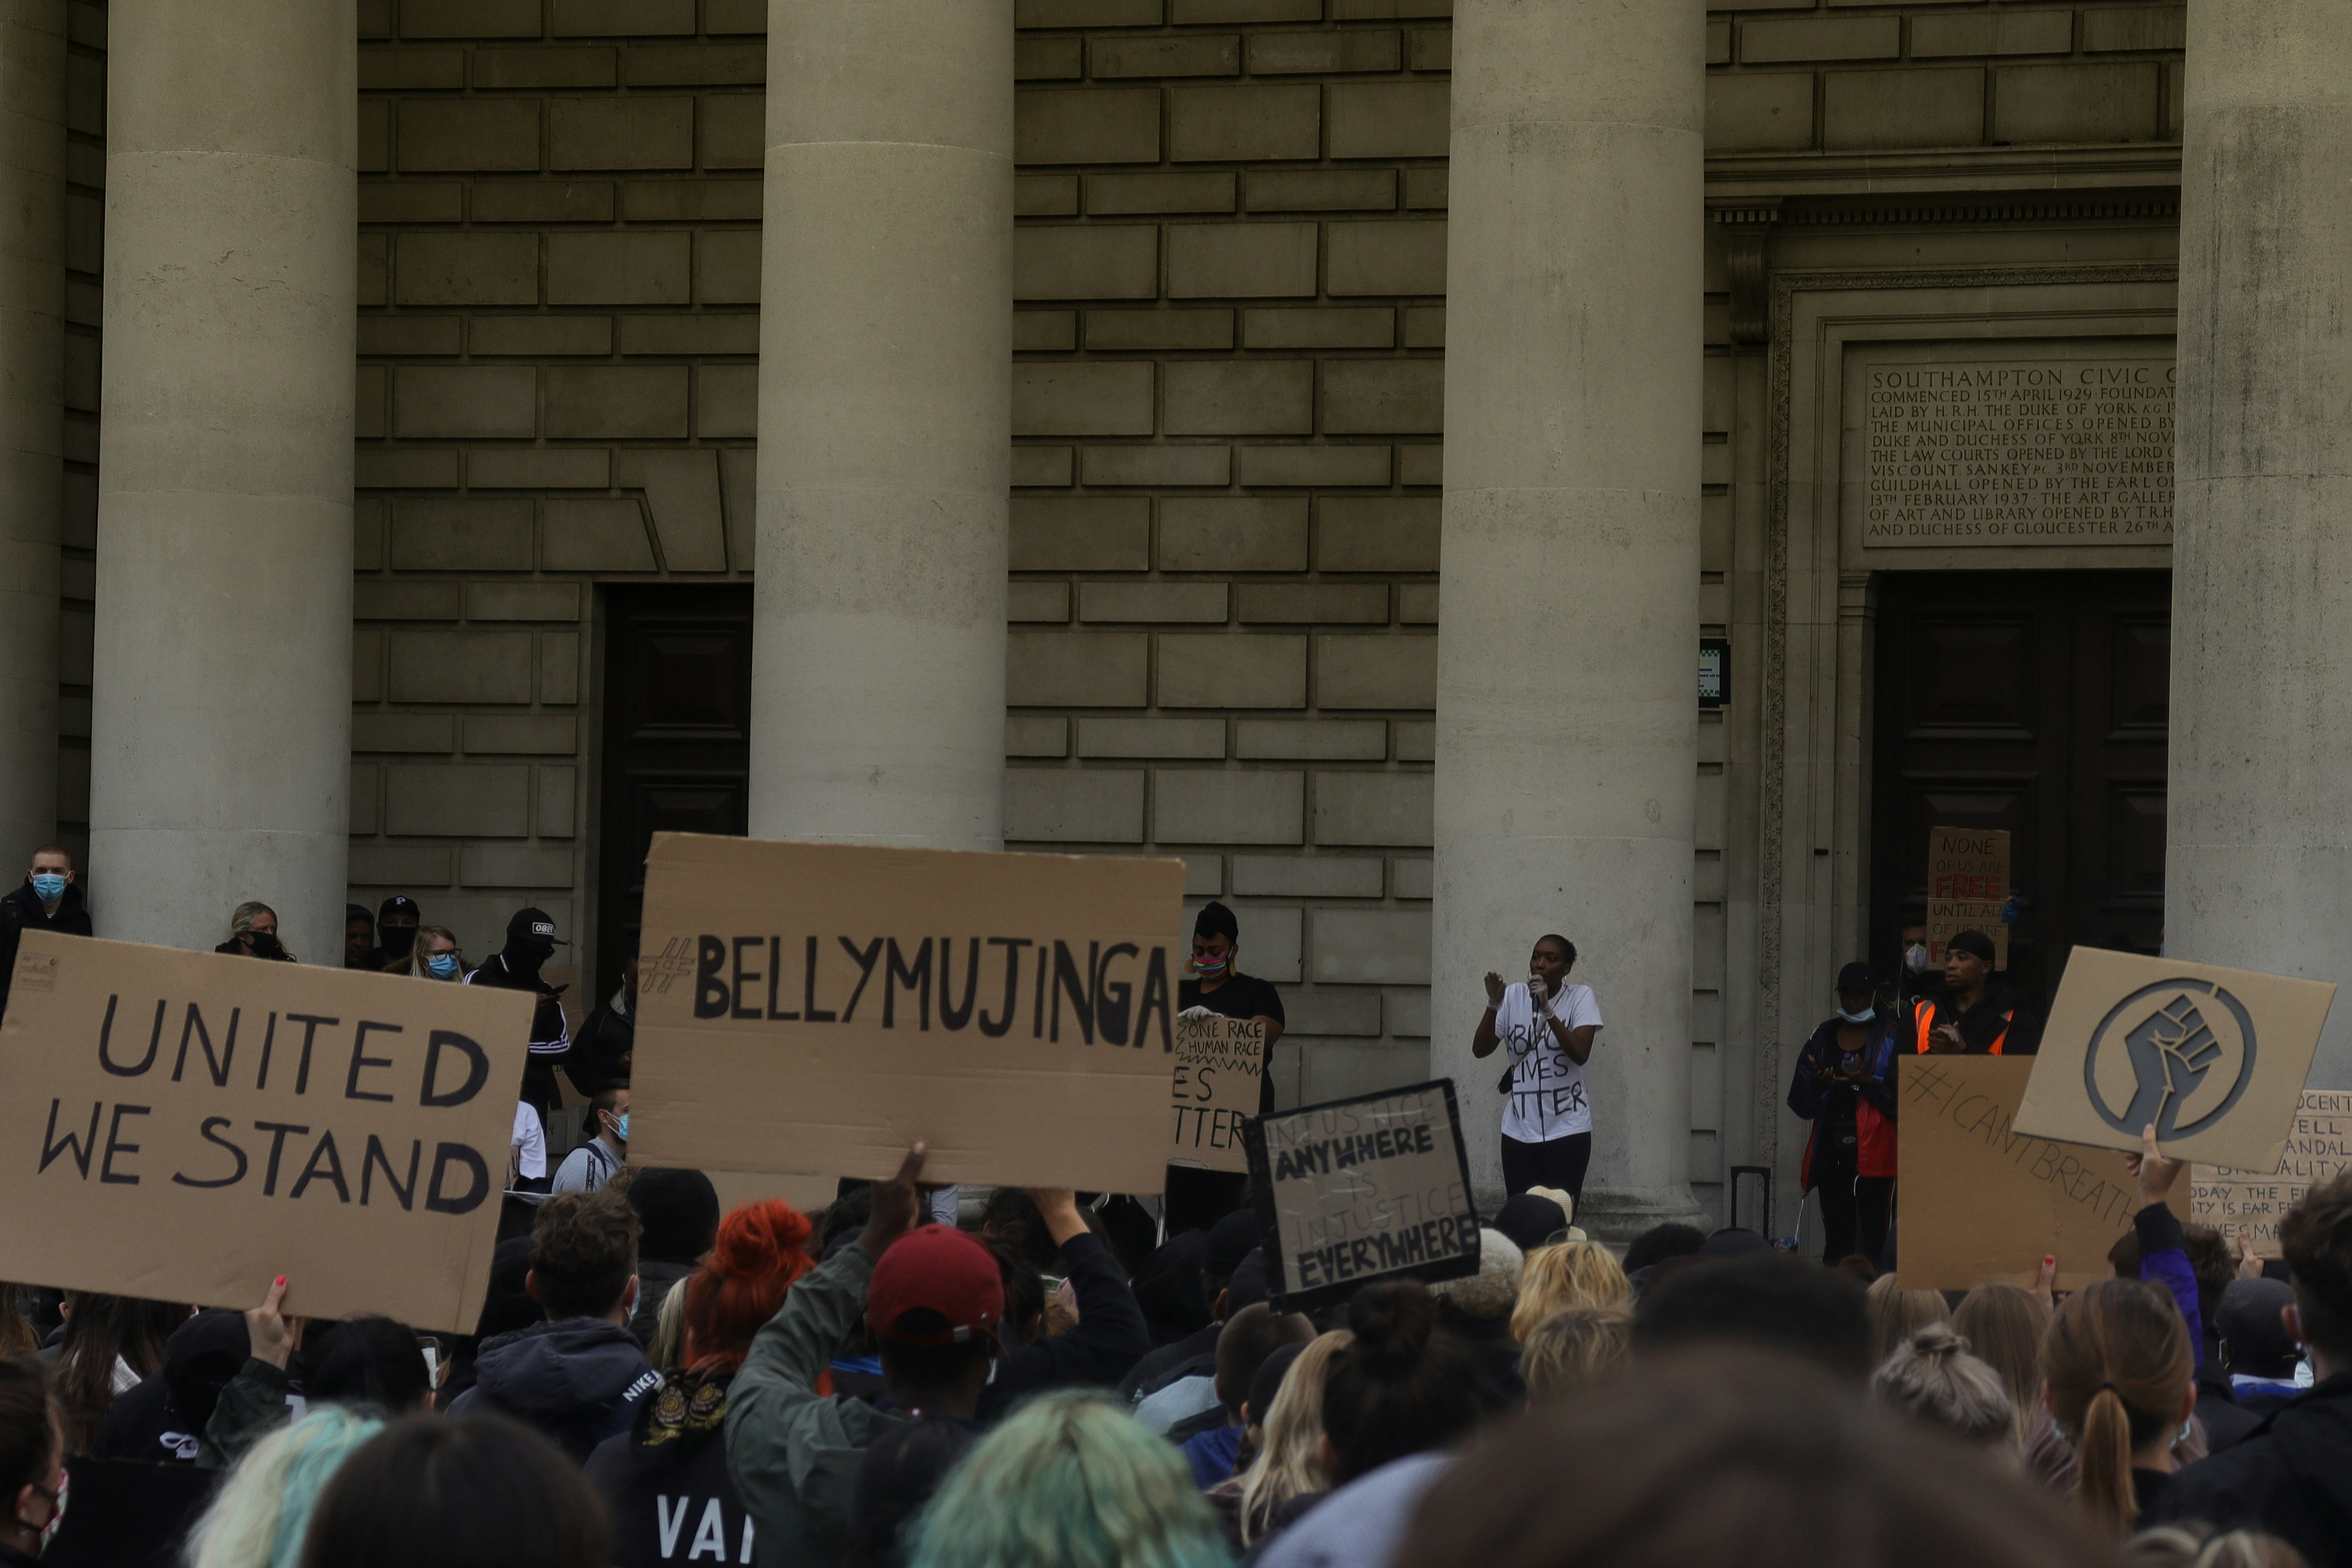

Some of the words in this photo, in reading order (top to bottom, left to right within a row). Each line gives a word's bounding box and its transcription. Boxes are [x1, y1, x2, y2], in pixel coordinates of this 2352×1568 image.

[1873, 369, 2062, 388] SOUTHAMPTON
[2080, 368, 2149, 384] CIVIC
[1871, 390, 1970, 404] COMMENCED
[2010, 389, 2055, 401] APRIL
[2100, 386, 2176, 399] FOUNDAT
[1872, 406, 1904, 418] LAID
[1911, 405, 1929, 417] BY
[1984, 404, 2011, 416] THE
[2019, 404, 2059, 415] DUKE
[2067, 403, 2088, 415] OF
[2094, 402, 2137, 414] YORK
[1871, 421, 1899, 433] THE
[1907, 419, 1996, 432] MUNICIPAL
[2004, 418, 2074, 431] OFFICES
[2082, 417, 2151, 429] OPENED
[1873, 435, 1911, 447] DUKE
[1916, 435, 1948, 446] AND
[1956, 433, 2027, 446] DUCHESS
[2035, 433, 2056, 445] OF
[2061, 432, 2104, 445] YORK
[2136, 431, 2175, 443] NOV
[1870, 450, 1897, 462] THE
[1904, 449, 1935, 462] LAW
[1941, 448, 2000, 461] COURTS
[2007, 447, 2064, 461] OPENED
[2070, 447, 2088, 460] BY
[2092, 447, 2119, 459] THE
[2125, 446, 2163, 459] LORD
[1871, 464, 1958, 476] VISCOUNT
[1966, 463, 2031, 476] SANKEY
[2083, 461, 2175, 473] NOVEMBER
[1871, 478, 1961, 491] GUILDHALL
[1969, 477, 2038, 490] OPENED
[2046, 477, 2064, 490] BY
[2069, 476, 2099, 489] THE
[2107, 476, 2151, 488] EARL
[1904, 493, 1989, 506] FEBRUARY
[1995, 493, 2028, 505] 1937
[2041, 492, 2072, 504] THE
[2078, 491, 2110, 504] ART
[2118, 491, 2175, 503] GALLER
[1869, 508, 1890, 522] OF
[1894, 508, 1927, 521] ART
[1930, 508, 1966, 521] AND
[1973, 507, 2037, 520] LIBRARY
[2042, 506, 2105, 520] OPENED
[2111, 506, 2131, 519] BY
[1869, 523, 1904, 536] AND
[1909, 523, 1982, 535] DUCHESS
[1988, 523, 2009, 535] OF
[2014, 522, 2119, 535] GLOUCESTER
[1943, 837, 1997, 855] NONE
[1936, 860, 1954, 873] OF
[1958, 860, 1975, 872] US
[1979, 860, 2004, 873] ARE
[1936, 873, 2001, 900] FREE
[1933, 904, 1976, 917] UNTIL
[1933, 923, 1953, 934] OF
[639, 934, 1173, 1054] #BELLYMUJINGA
[1188, 1021, 1219, 1038] ONE
[1228, 1020, 1263, 1039] RACE
[98, 994, 490, 1108] UNITED
[1188, 1041, 1228, 1054] HUMAN
[1234, 1041, 1260, 1056] RACE
[1172, 1067, 1216, 1102] ES
[1513, 1081, 1588, 1120] TTER
[1172, 1104, 1247, 1150] TTER
[1266, 1091, 1436, 1149] INJUSTICE
[2292, 1119, 2343, 1135] ELL
[1275, 1124, 1434, 1182] ANYWHERE
[2285, 1138, 2352, 1156] ANDAL
[38, 1098, 151, 1185] WE
[171, 1116, 490, 1216] STAND
[1346, 1172, 1377, 1203] IS
[2246, 1187, 2279, 1199] THE
[1296, 1181, 1467, 1250] INJUSTICE
[2192, 1201, 2215, 1215] ITY
[2223, 1202, 2236, 1215] IS
[2242, 1202, 2272, 1215] FAR
[1297, 1213, 1478, 1289] EVERYWHERE
[622, 1372, 655, 1402] NIKE
